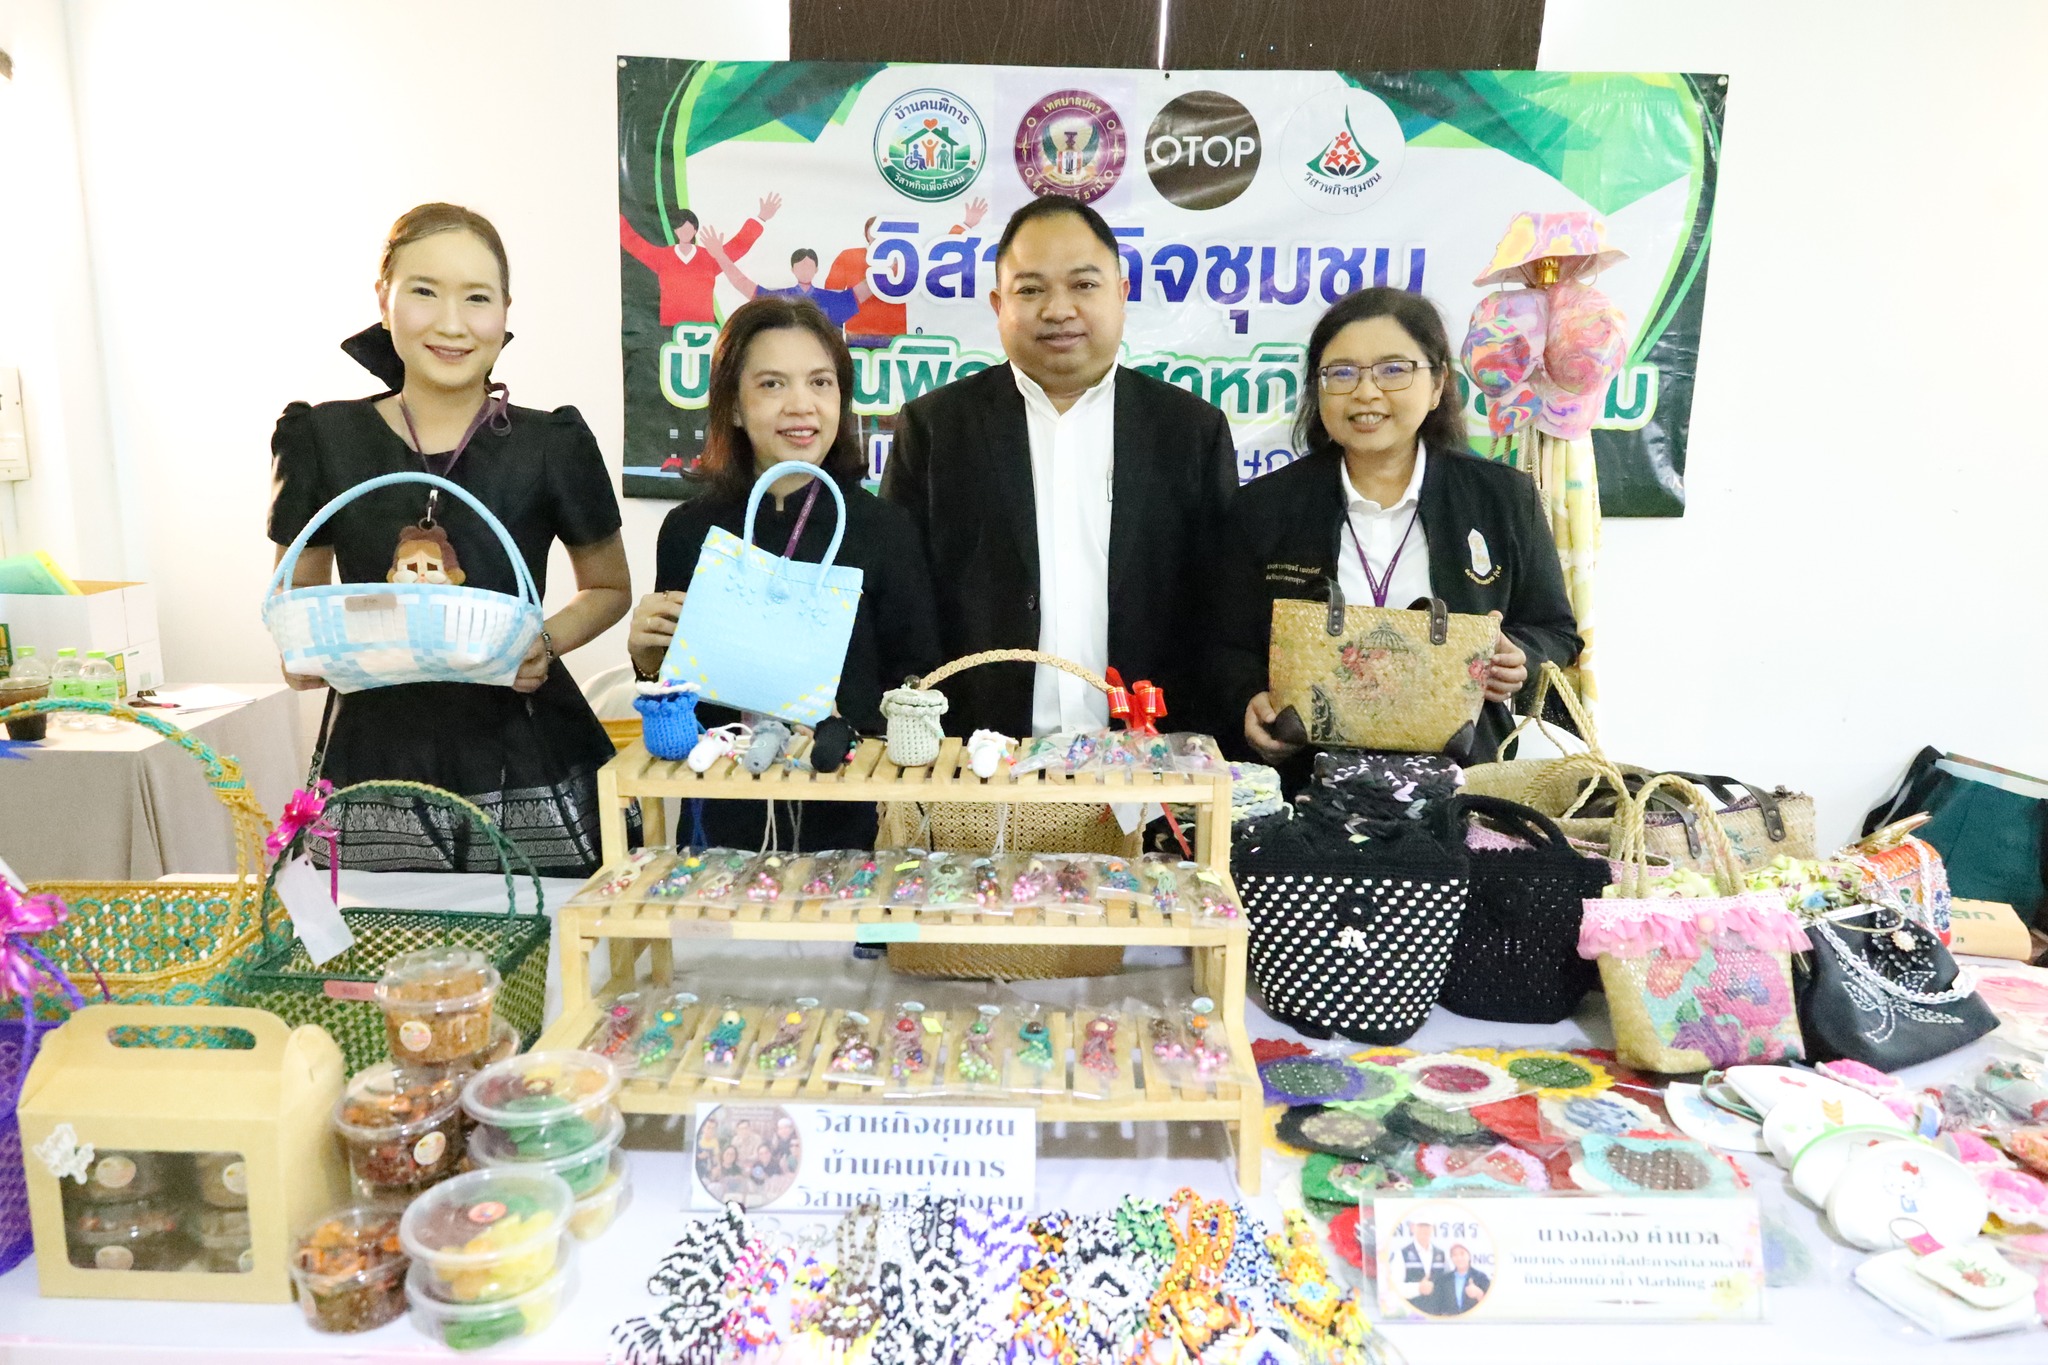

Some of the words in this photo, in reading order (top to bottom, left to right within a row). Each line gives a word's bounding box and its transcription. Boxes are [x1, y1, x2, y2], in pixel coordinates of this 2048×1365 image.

[895, 98, 970, 125] บ้านคนพิการ
[1043, 95, 1102, 114] เทศบาลนคร
[1151, 135, 1256, 168] OTOP
[893, 173, 966, 192] วิสาหกิจเพื่อสังคม
[1304, 171, 1382, 198] วิสาหกิจชุมชน
[816, 1109, 1016, 1143] วิสาหกิจชุมชน
[823, 1149, 1006, 1179] บ้านคนพิการ
[1638, 1275, 1706, 1290] Marbling
[1710, 1279, 1732, 1289] art
